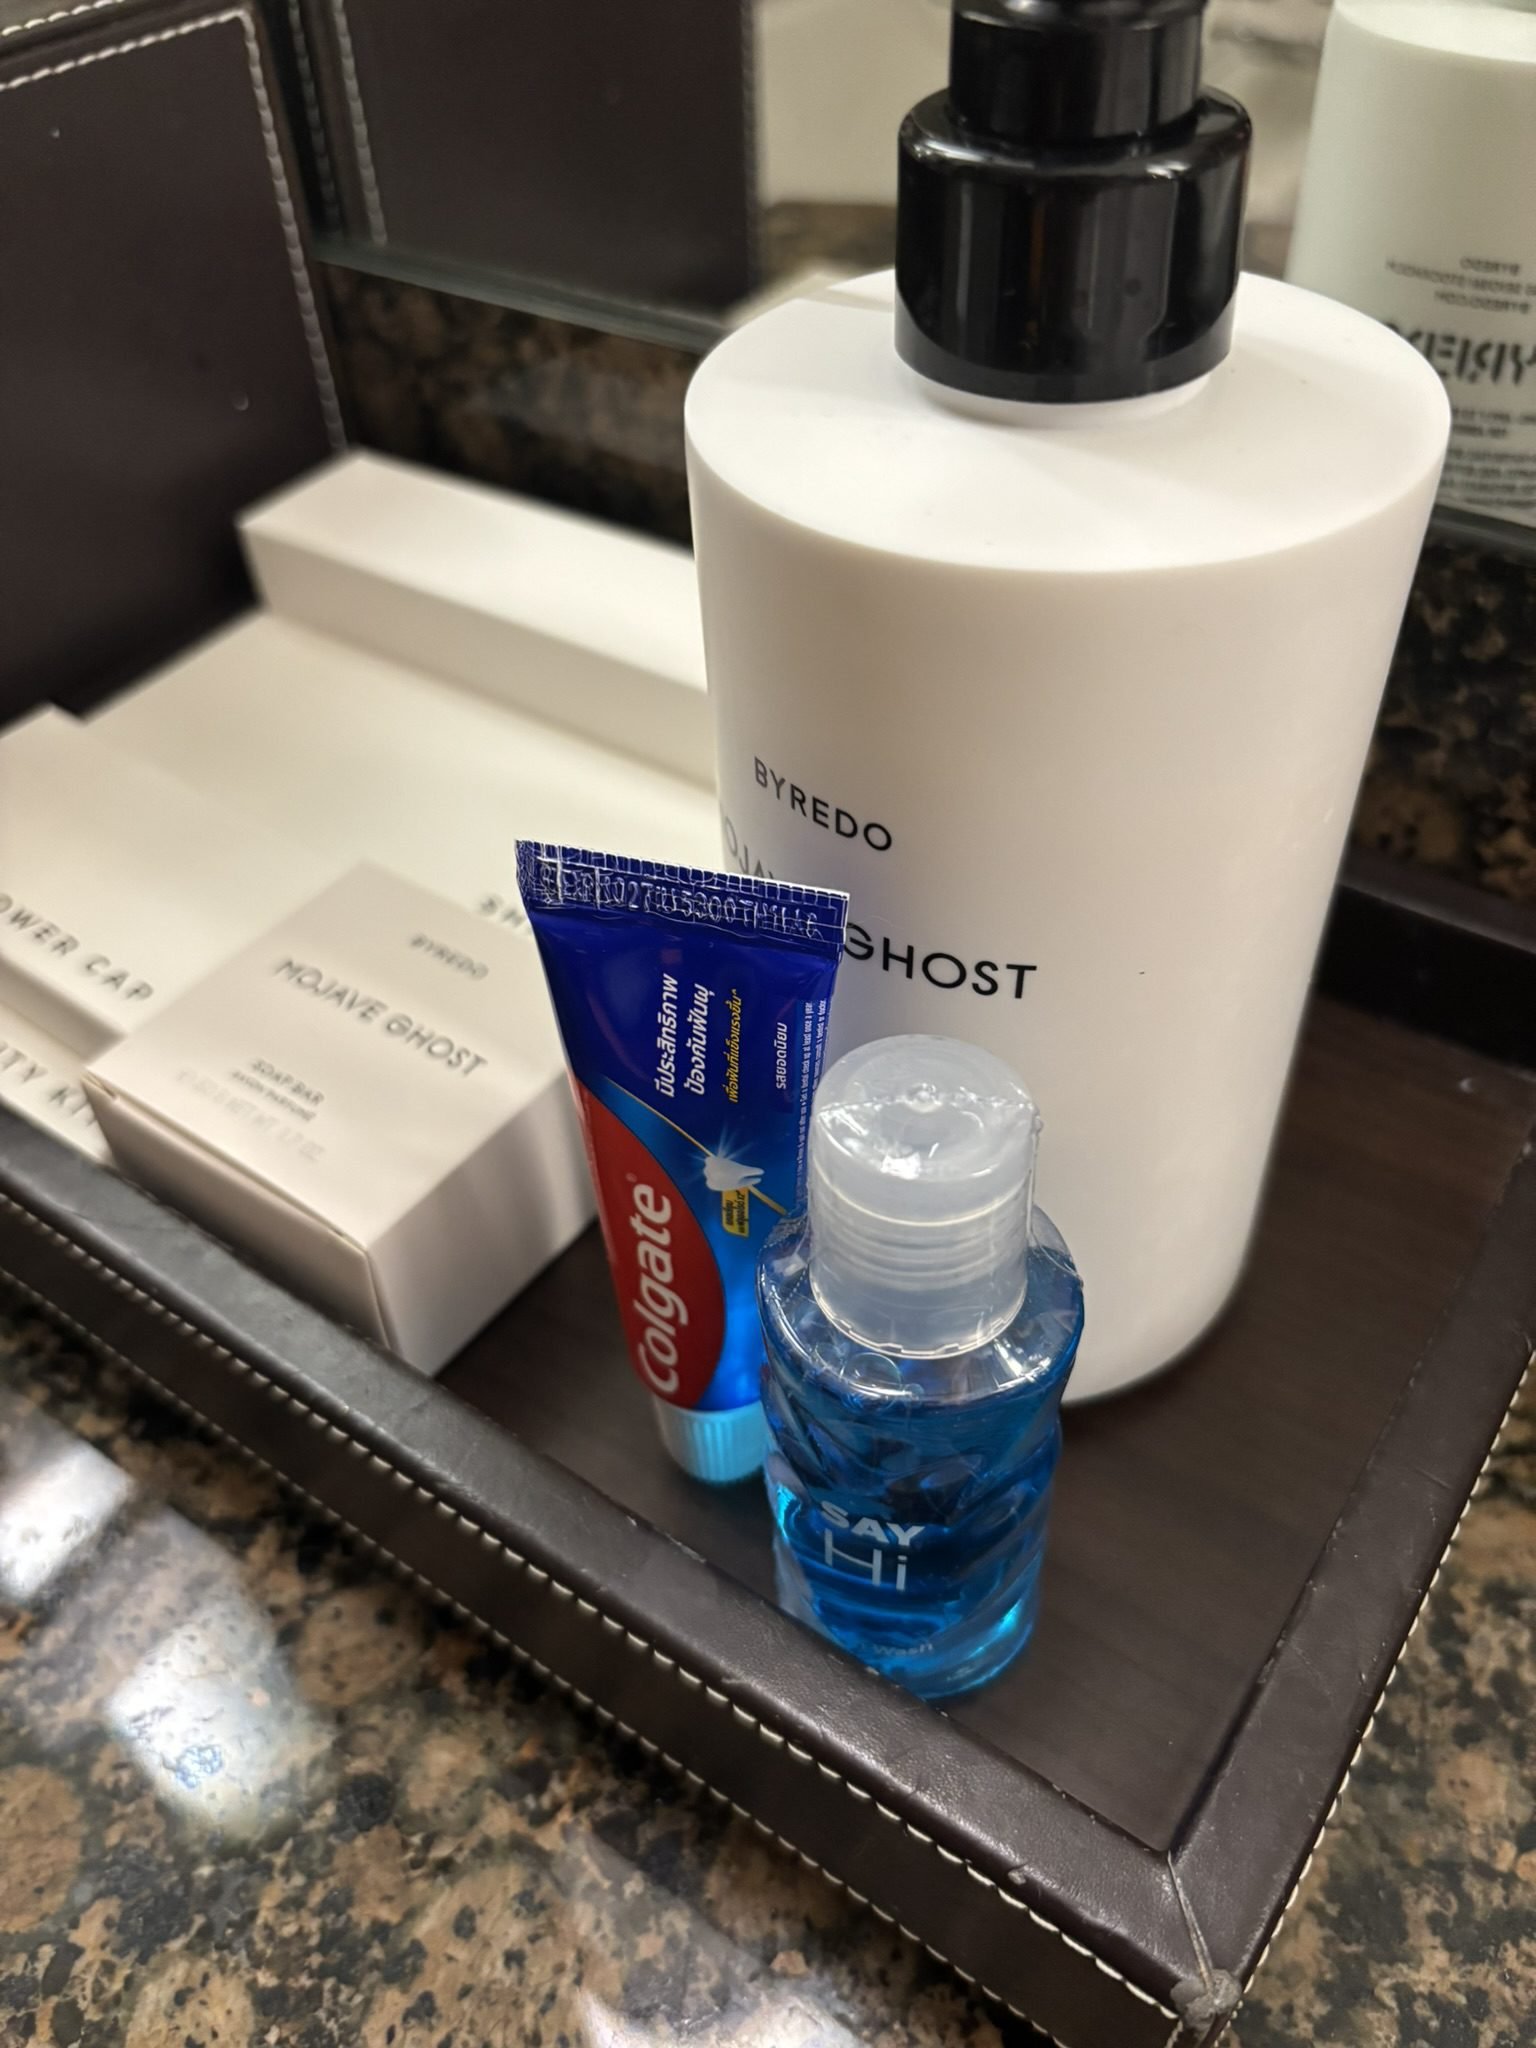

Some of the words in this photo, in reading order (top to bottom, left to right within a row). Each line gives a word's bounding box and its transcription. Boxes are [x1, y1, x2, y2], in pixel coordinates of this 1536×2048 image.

[754, 755, 893, 852] BYREDO
[80, 953, 154, 1002] CAP
[844, 921, 1038, 1000] GHOST
[273, 958, 388, 1022] MOJAVE
[385, 1012, 489, 1077] GHOST
[656, 972, 679, 1099] มีประสิทธิภาพ
[684, 983, 716, 1097] ป้องกันฟันผุ
[629, 1183, 689, 1394] Colgate
[820, 1500, 925, 1547] SAY
[824, 1528, 908, 1591] Hi
